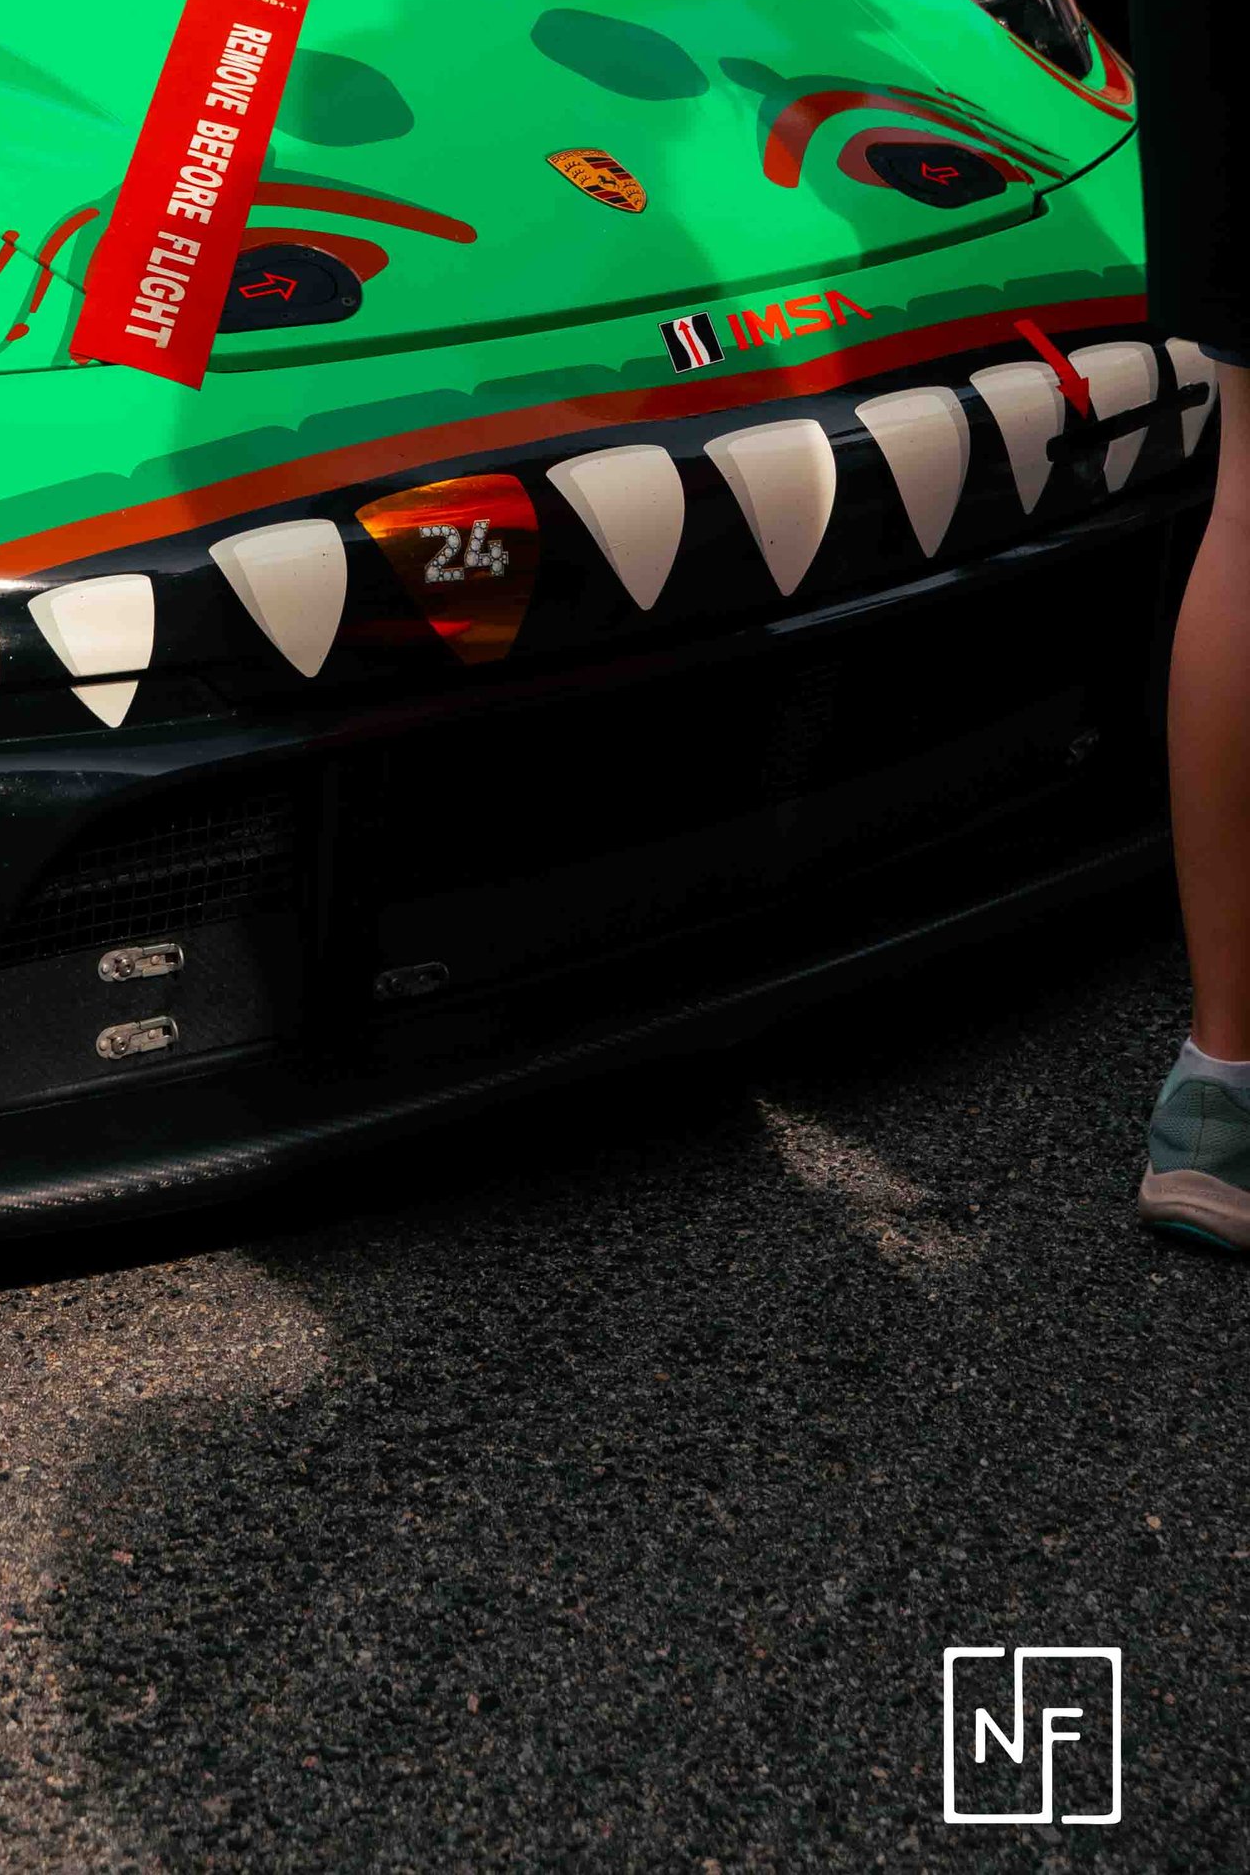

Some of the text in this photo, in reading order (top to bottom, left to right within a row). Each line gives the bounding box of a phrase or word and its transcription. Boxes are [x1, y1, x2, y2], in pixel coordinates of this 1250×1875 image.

[125, 22, 273, 350] REMOVE BEFORE FLIGHT
[726, 290, 874, 351] IMSA
[418, 519, 510, 584] 24
